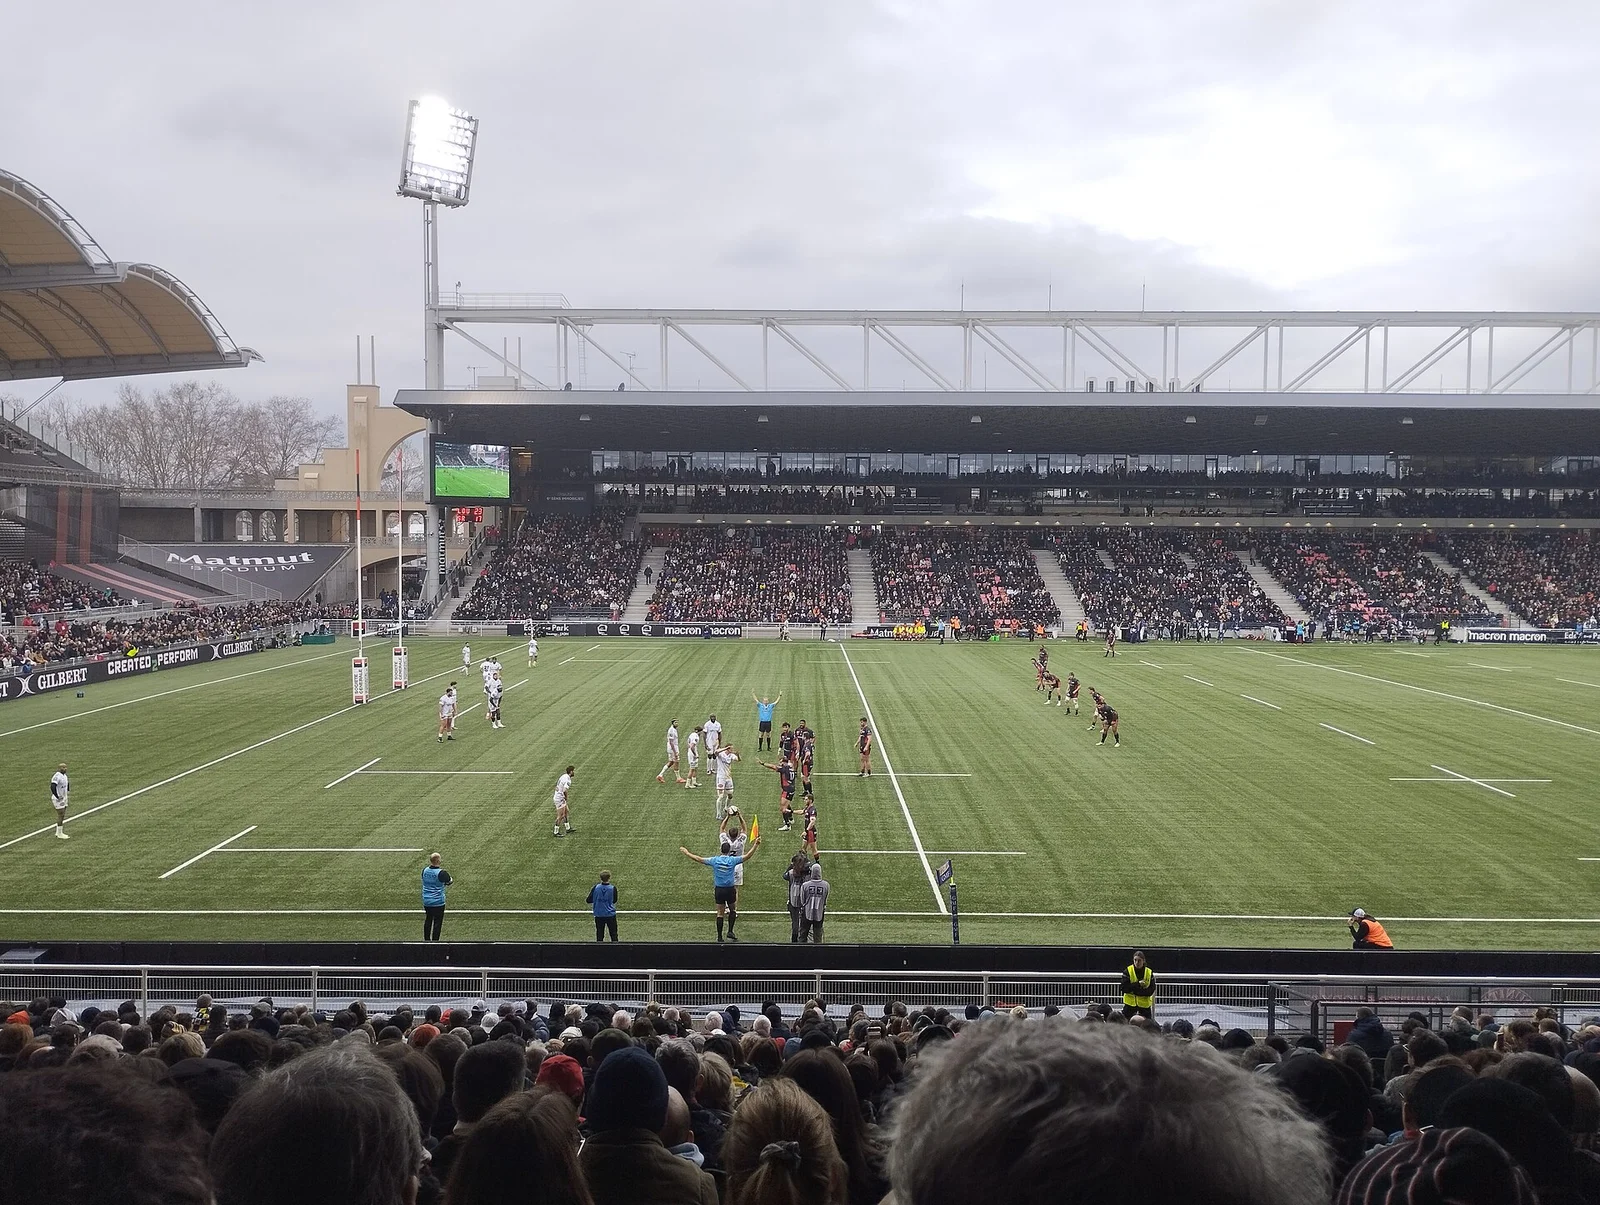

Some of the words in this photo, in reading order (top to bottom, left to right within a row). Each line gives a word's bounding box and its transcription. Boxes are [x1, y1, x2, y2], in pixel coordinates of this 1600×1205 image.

[167, 552, 314, 566] Matmut
[664, 626, 702, 635] macron
[710, 626, 741, 635] acron
[1469, 630, 1505, 641] macron
[1509, 632, 1546, 642] macron
[222, 640, 253, 656] GILBERT
[107, 656, 151, 675] CREATED
[157, 648, 199, 666] PERFORM
[37, 667, 87, 690] GILBERT
